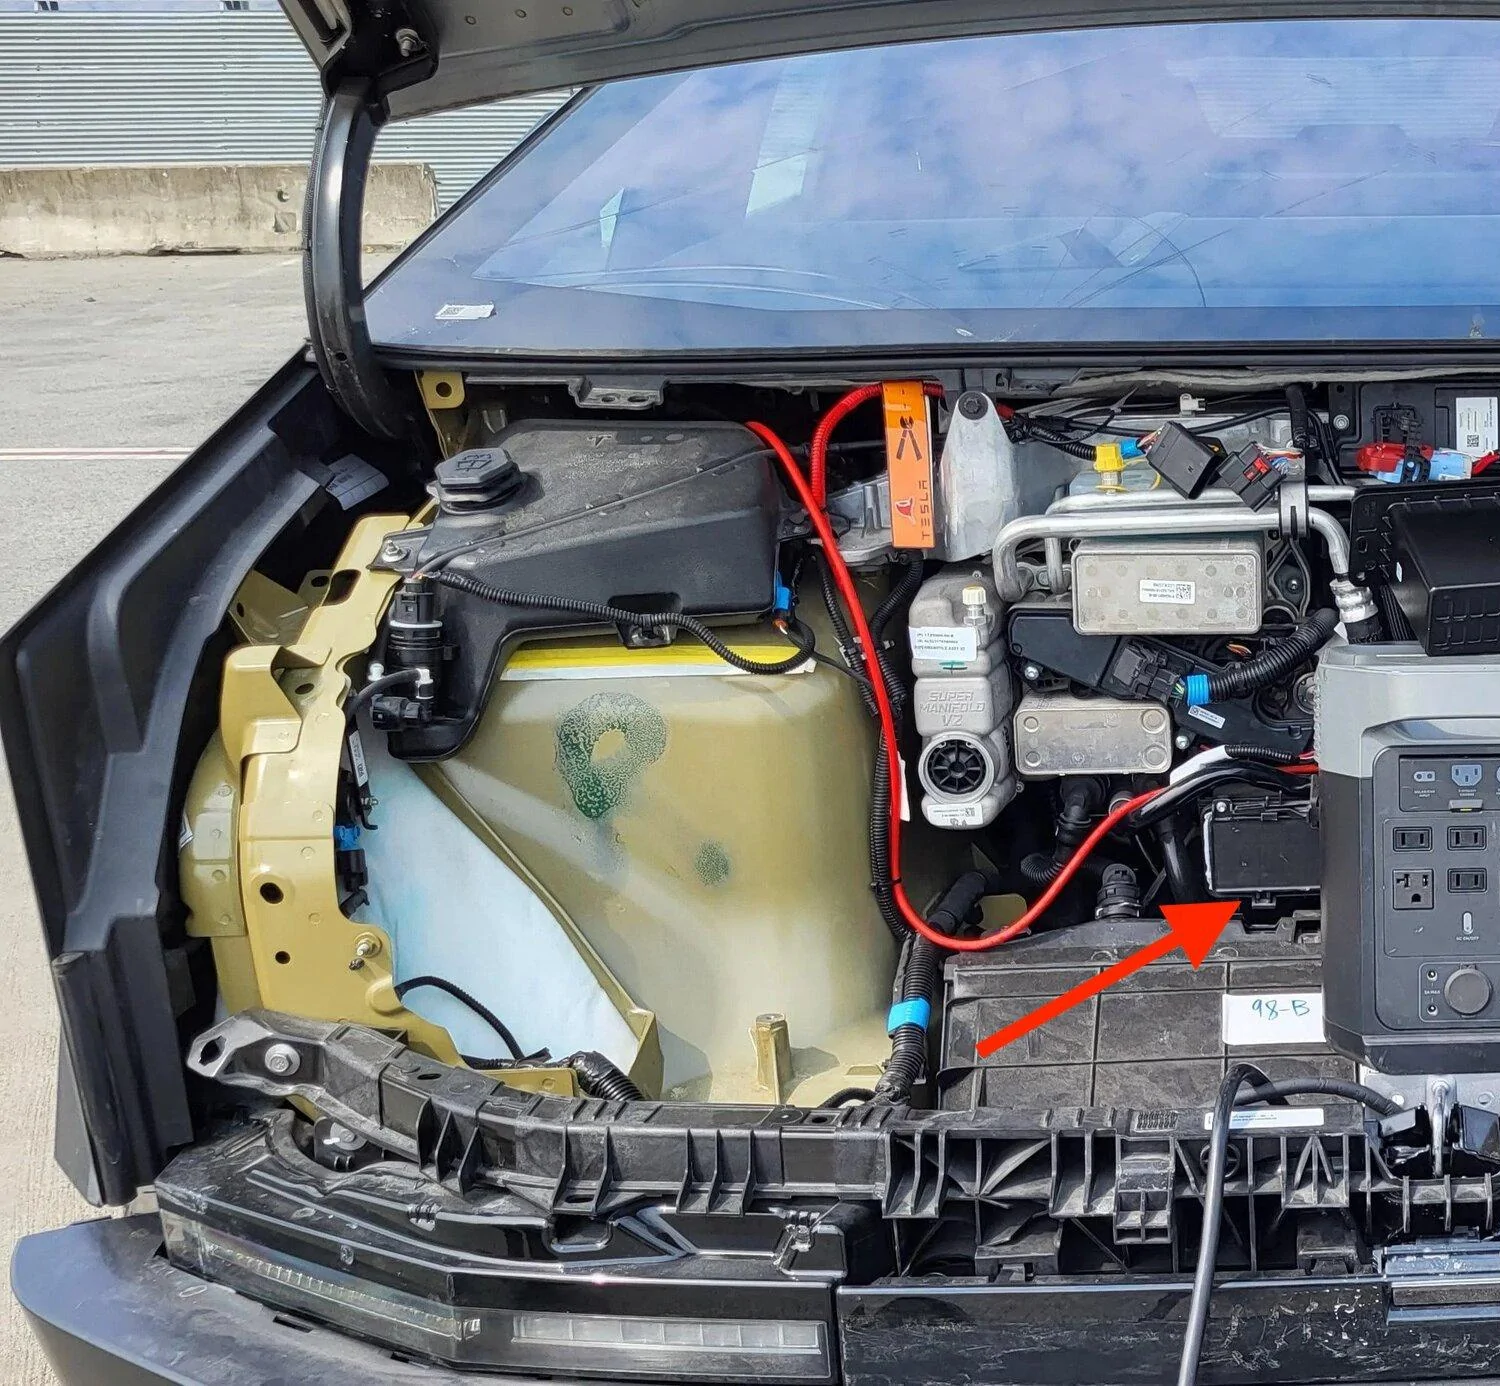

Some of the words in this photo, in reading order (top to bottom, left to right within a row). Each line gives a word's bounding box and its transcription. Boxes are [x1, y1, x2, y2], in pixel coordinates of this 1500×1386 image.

[918, 480, 931, 541] TESLA
[928, 691, 974, 702] SUPER
[919, 702, 986, 713] MANIFOLD
[942, 714, 963, 726] V2
[1252, 999, 1310, 1021] 98-B
